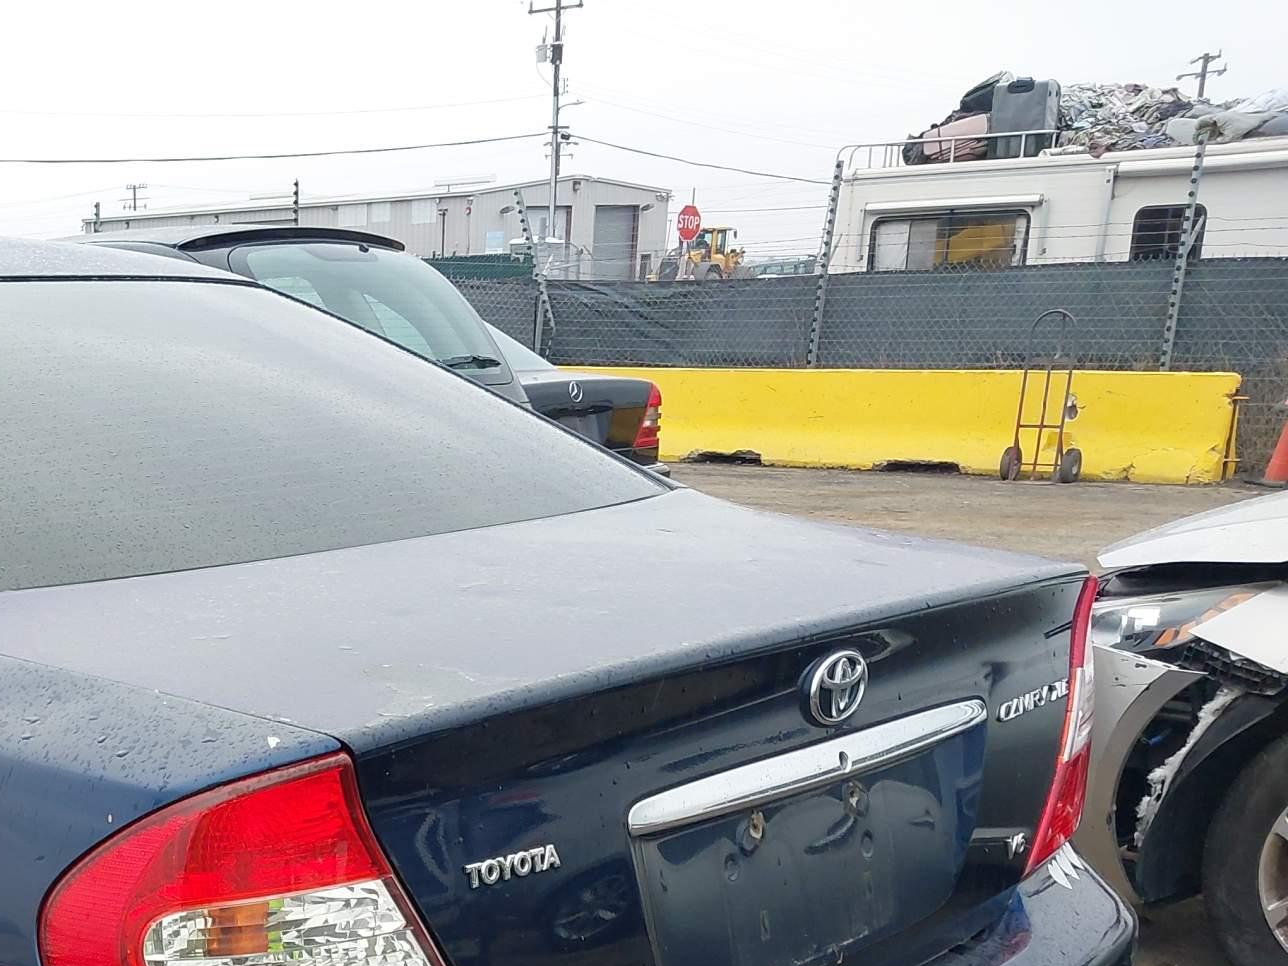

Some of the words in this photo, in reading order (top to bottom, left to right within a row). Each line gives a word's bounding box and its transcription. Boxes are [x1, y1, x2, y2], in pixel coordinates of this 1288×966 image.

[678, 215, 700, 230] STOP
[997, 685, 1049, 721] CAMRY
[464, 844, 560, 889] TOYOTA
